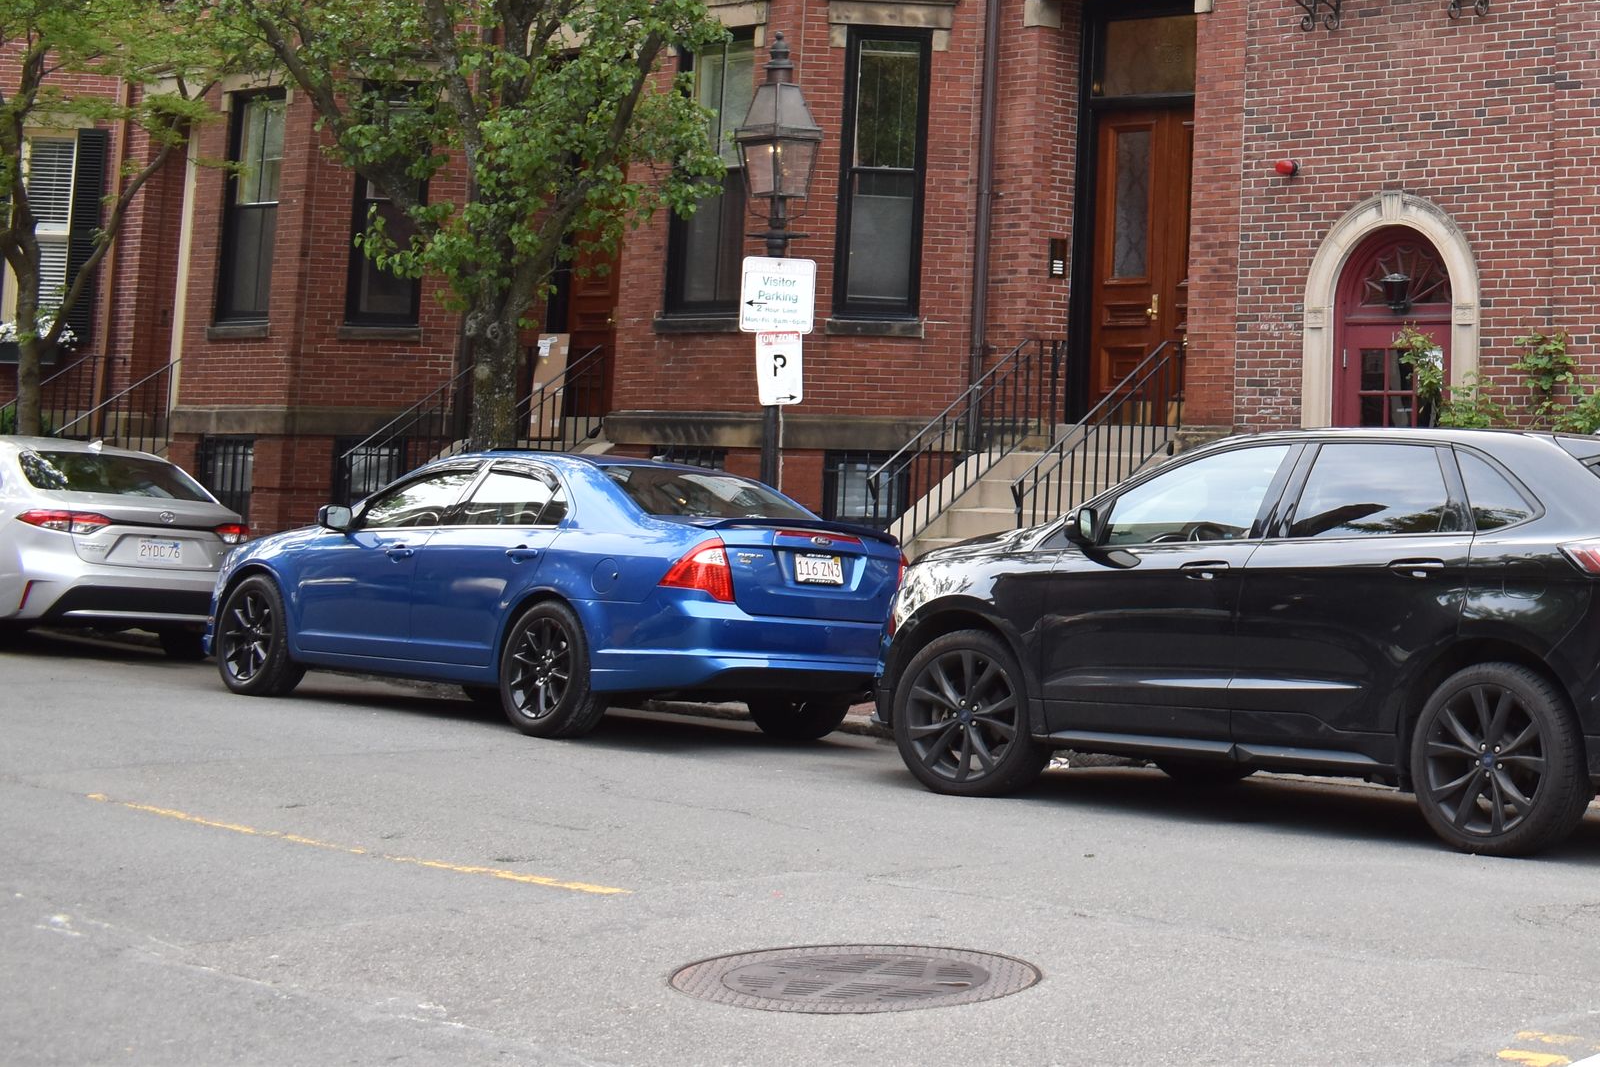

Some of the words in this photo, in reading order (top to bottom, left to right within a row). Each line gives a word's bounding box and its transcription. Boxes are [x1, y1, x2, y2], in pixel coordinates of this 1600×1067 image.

[763, 276, 796, 287] Visitor
[758, 290, 798, 303] Parking
[140, 545, 165, 557] 2YDC
[798, 560, 818, 575] 116
[821, 562, 840, 578] ZN3
